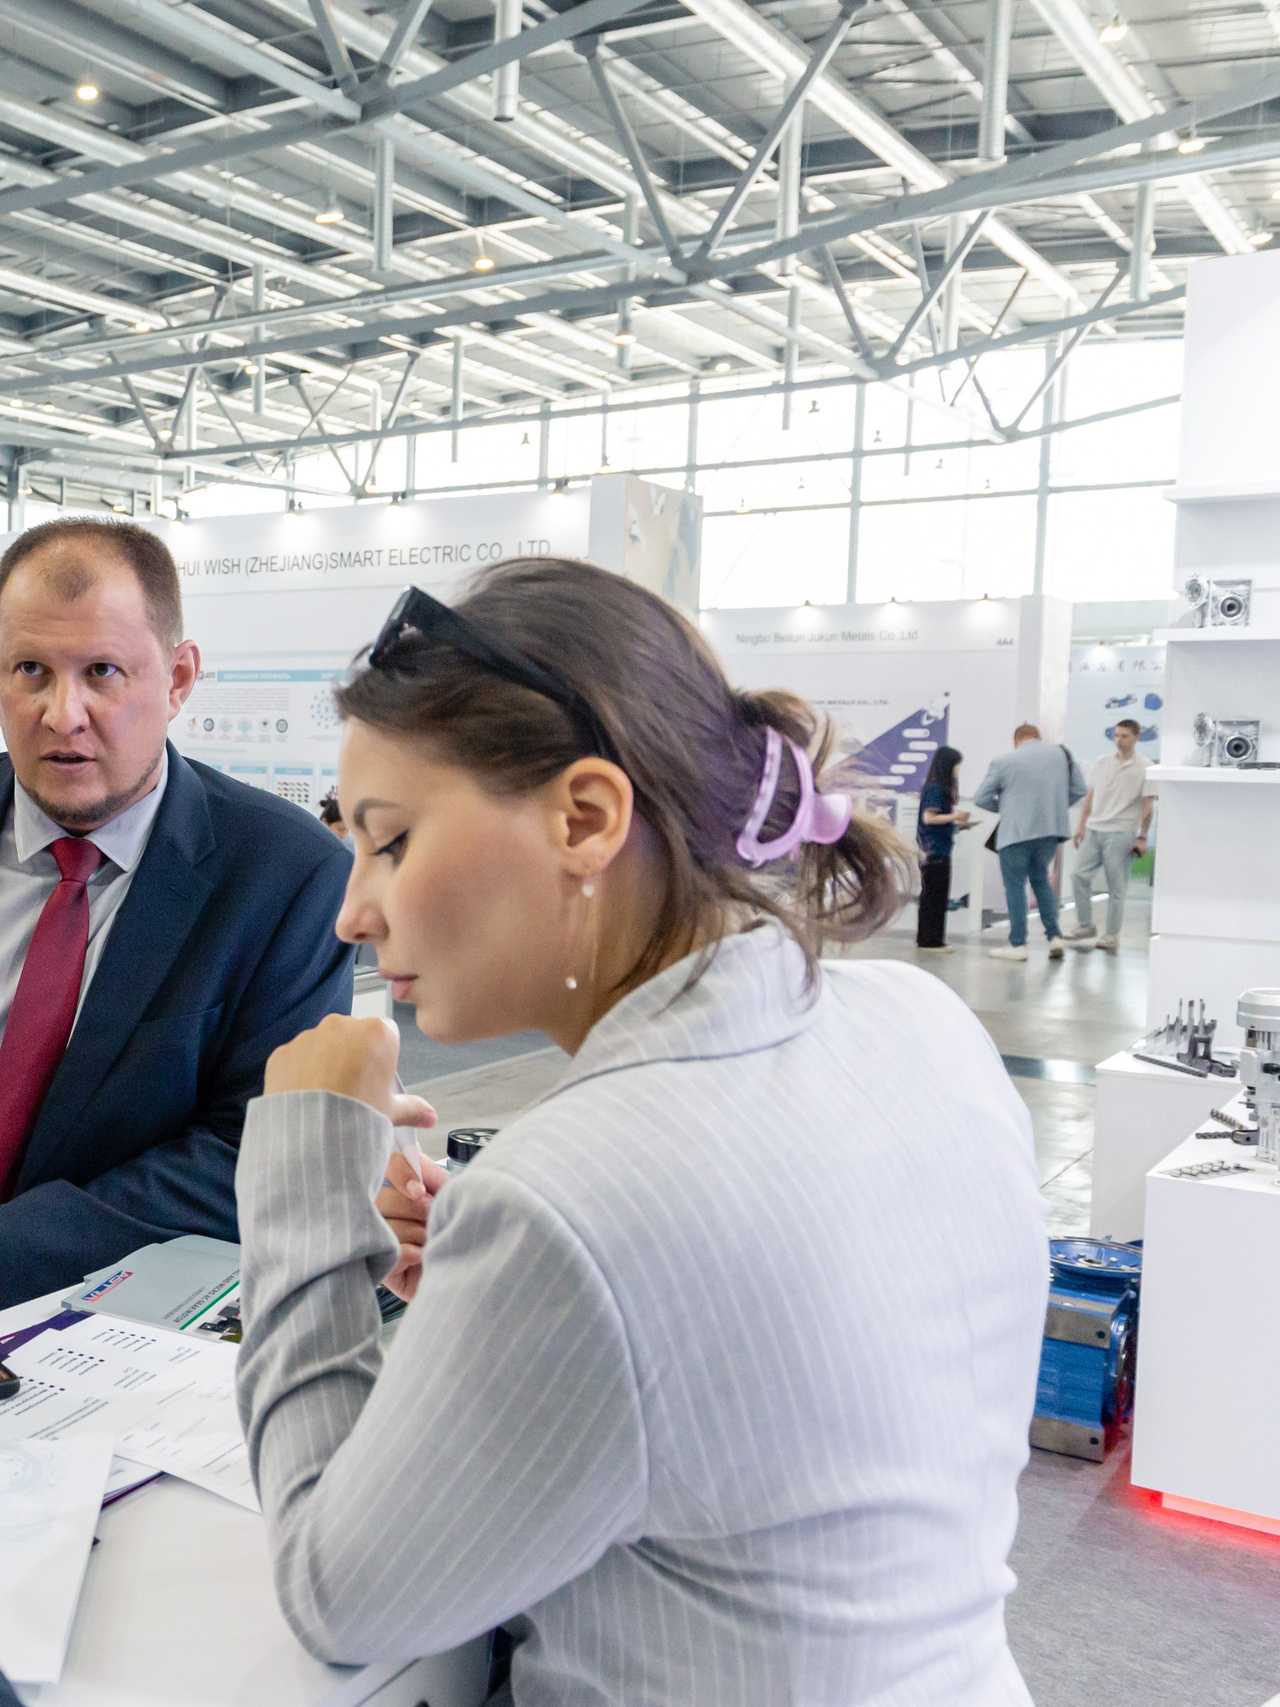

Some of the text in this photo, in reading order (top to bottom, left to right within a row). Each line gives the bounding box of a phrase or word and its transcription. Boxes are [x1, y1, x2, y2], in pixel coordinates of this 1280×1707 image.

[204, 558, 241, 575] WISH
[245, 549, 384, 577] (ZHEJIANG)SMART
[388, 544, 472, 566] ELECTRIC
[736, 633, 770, 646] Ningbo
[842, 630, 876, 641] Metals
